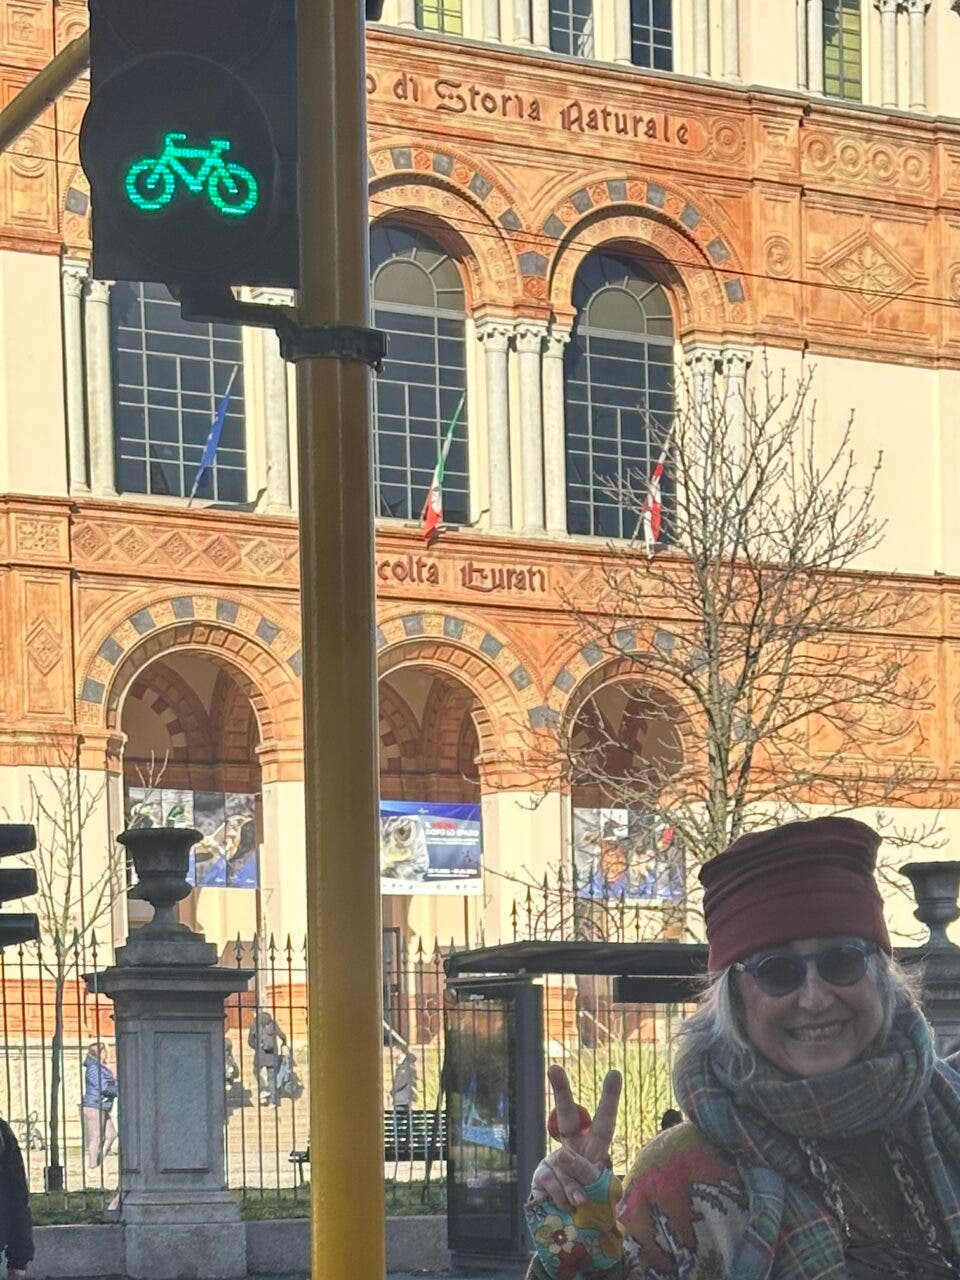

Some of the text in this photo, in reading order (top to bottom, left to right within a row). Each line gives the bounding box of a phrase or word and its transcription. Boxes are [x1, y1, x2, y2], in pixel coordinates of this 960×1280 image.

[393, 72, 419, 102] di
[434, 79, 541, 122] Storia
[560, 101, 689, 144] Naturale
